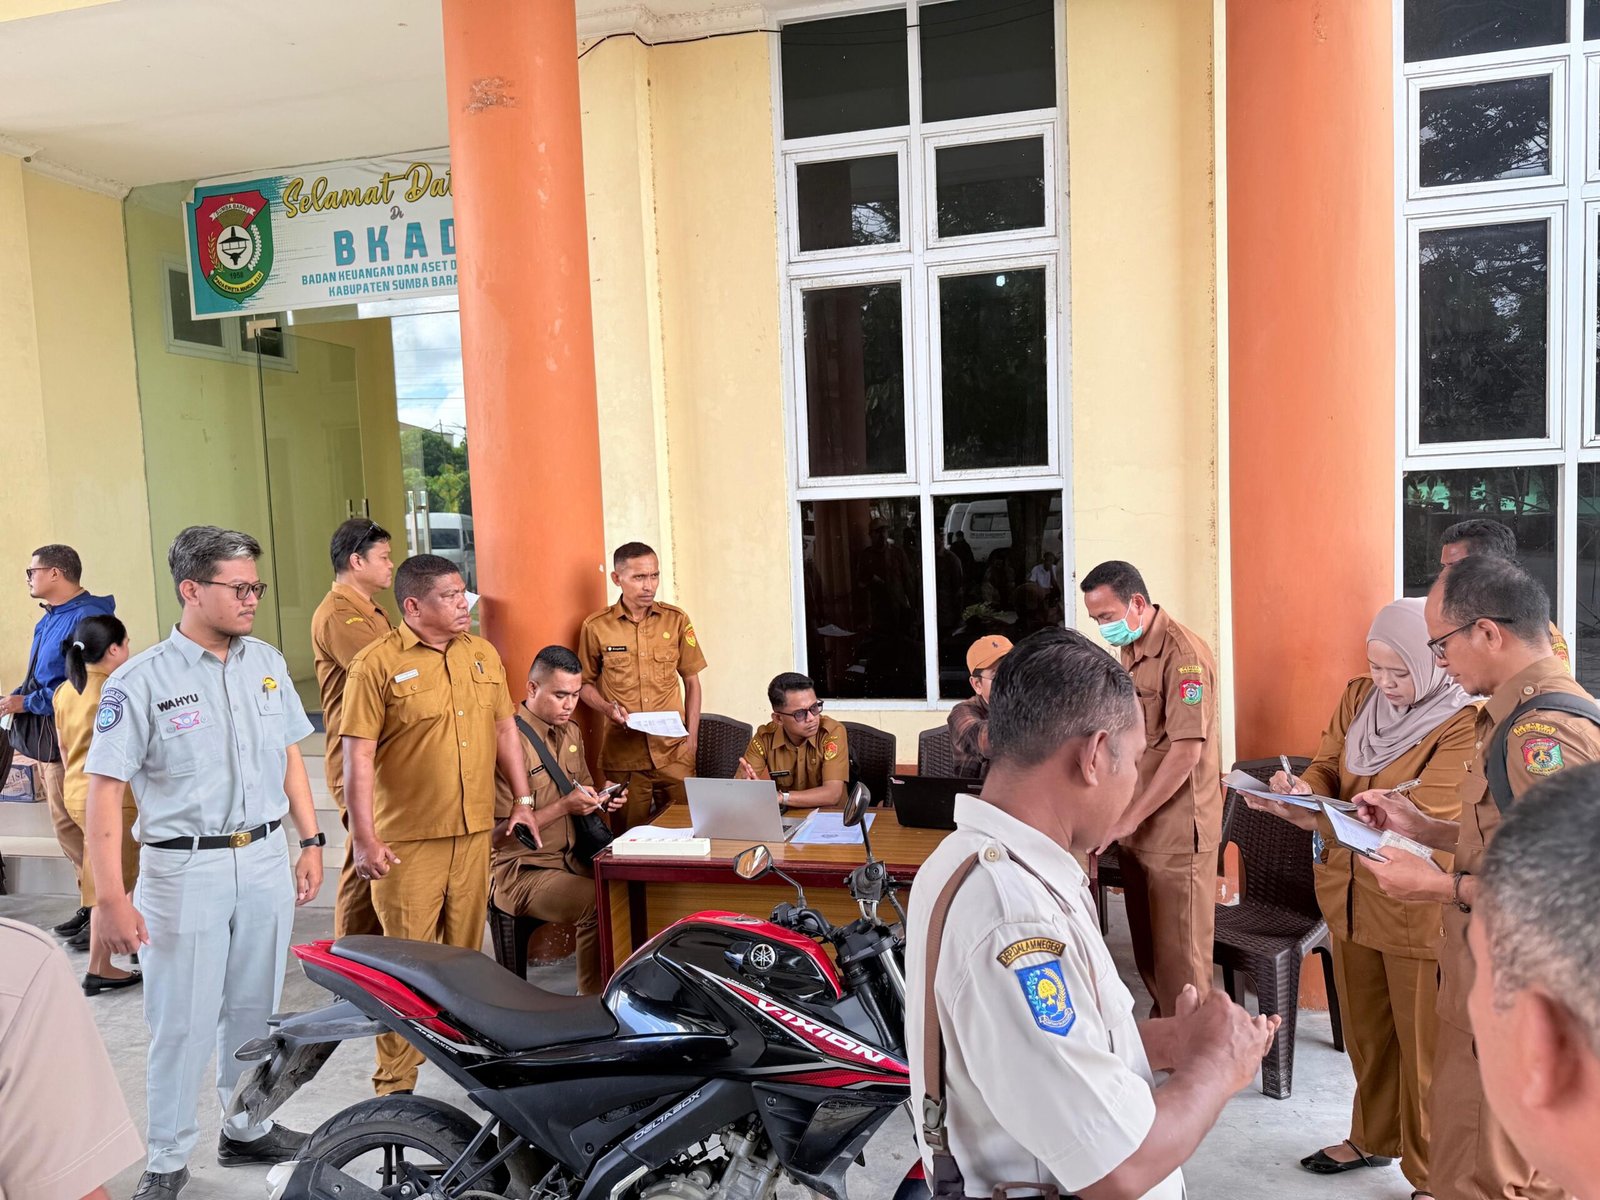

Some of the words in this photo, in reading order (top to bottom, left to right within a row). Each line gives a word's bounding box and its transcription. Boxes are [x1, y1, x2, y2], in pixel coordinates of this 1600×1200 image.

[282, 172, 404, 218] Selamat
[333, 218, 456, 266] BKAD
[301, 271, 337, 286] BADAN
[338, 265, 395, 281] KEUANGAN
[396, 263, 419, 276] DAN
[421, 260, 448, 274] ASET
[328, 280, 390, 298] KABUPATEN
[392, 277, 429, 291] SUMBA
[157, 693, 199, 712] WAHYU
[757, 998, 887, 1063] V-IXION
[634, 1089, 702, 1141] DELTABOX
